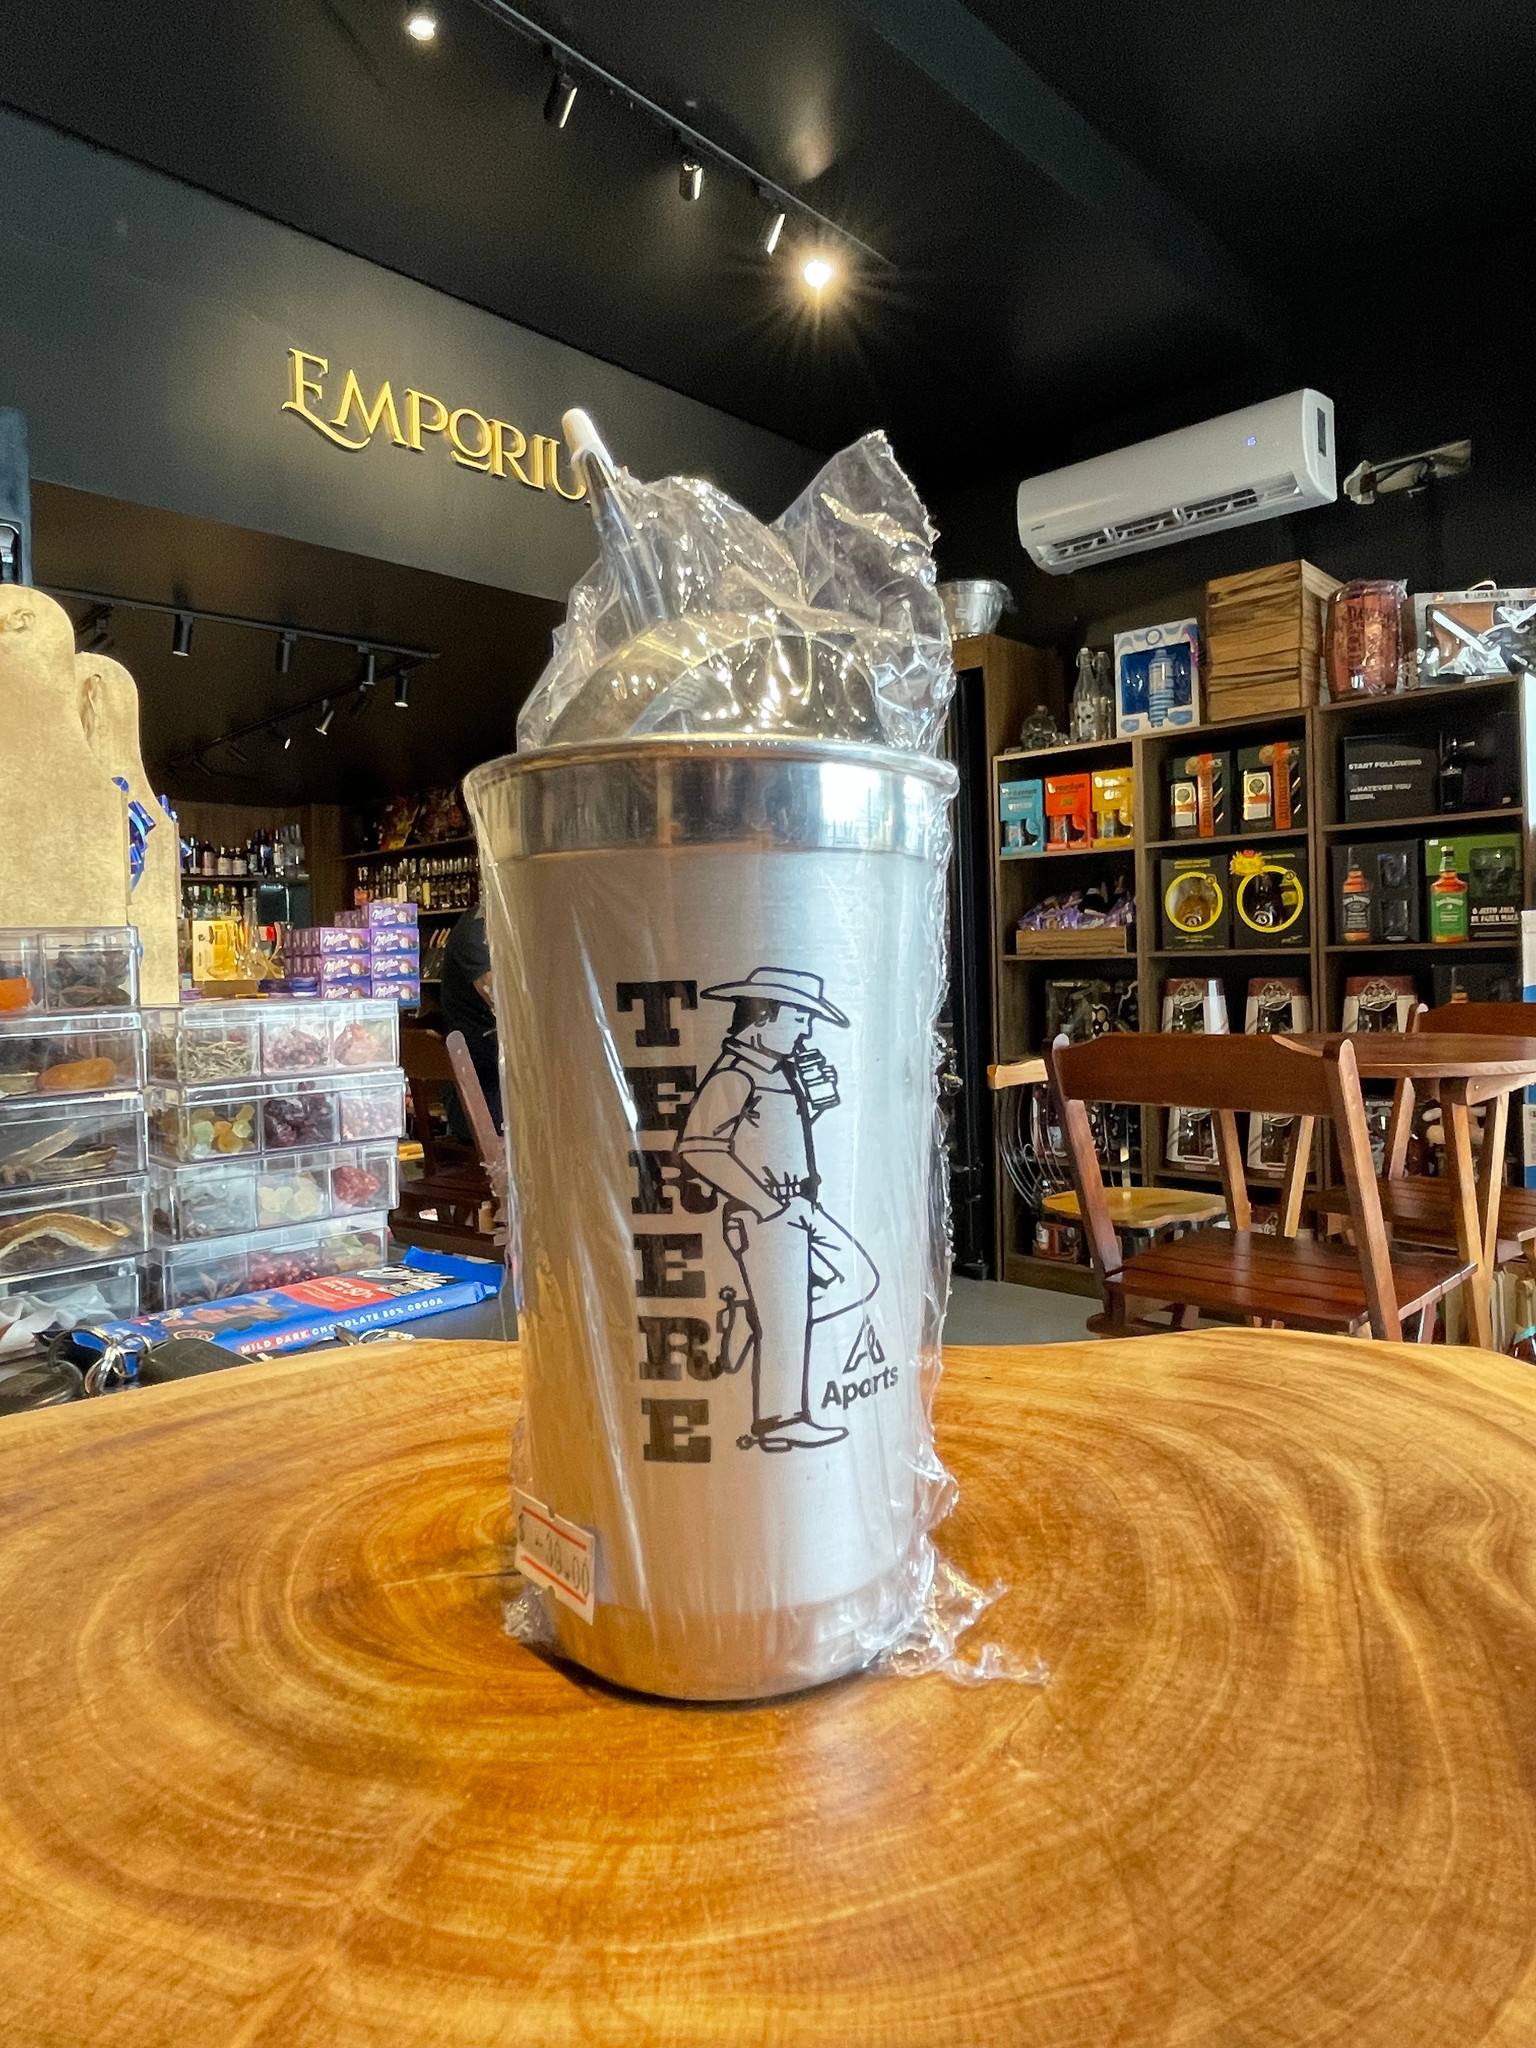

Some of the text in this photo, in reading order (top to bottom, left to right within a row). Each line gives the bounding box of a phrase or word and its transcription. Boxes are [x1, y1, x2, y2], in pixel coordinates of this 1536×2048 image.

[281, 347, 588, 503] EMPORIU
[616, 980, 722, 1463] TERERE
[240, 1339, 272, 1354] MILD
[276, 1329, 311, 1345] DARK
[407, 1297, 443, 1312] COCOA
[821, 1366, 899, 1411] Aports
